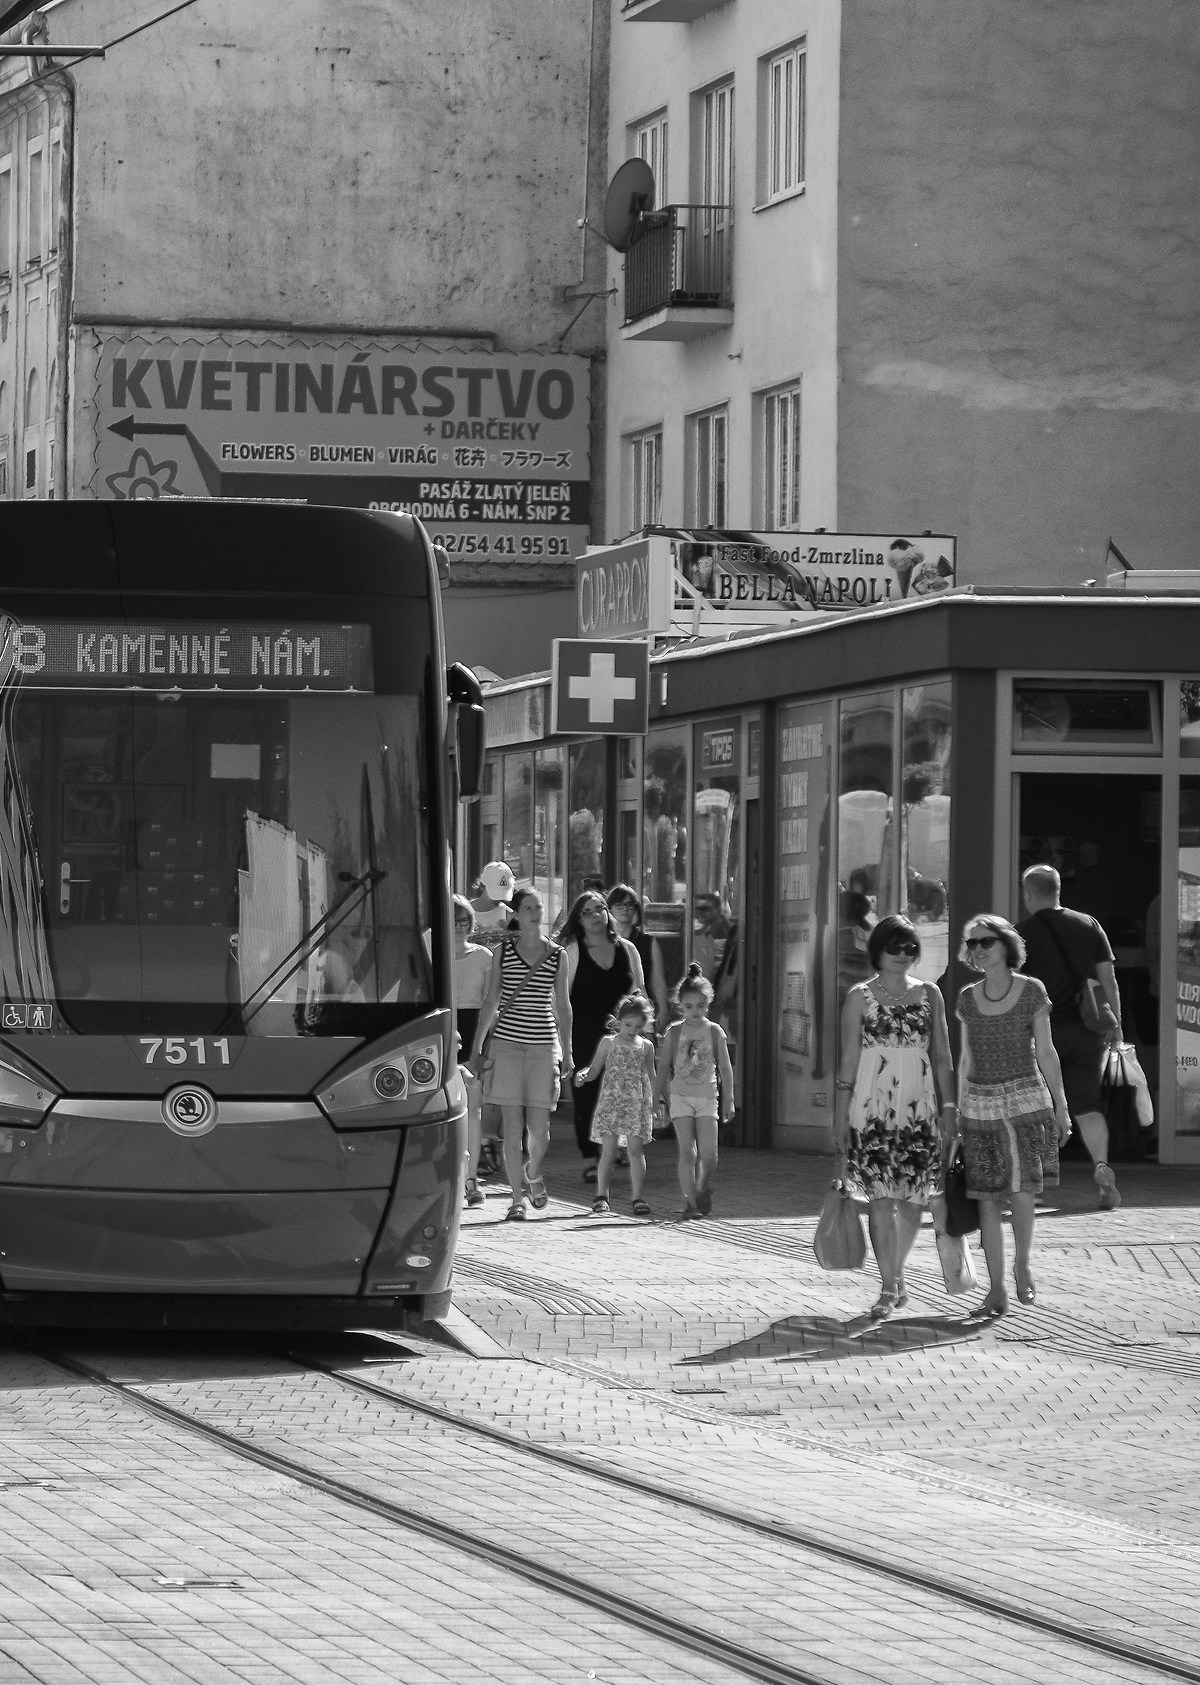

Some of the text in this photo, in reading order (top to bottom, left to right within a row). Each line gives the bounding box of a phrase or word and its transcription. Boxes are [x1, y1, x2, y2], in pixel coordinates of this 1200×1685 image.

[111, 352, 575, 419] KVETINÁRSTVO
[441, 417, 541, 440] DARČEKY
[221, 443, 438, 464] FLOWERS BLUMEN VIRÁG
[502, 451, 572, 468] フラワーズ
[420, 480, 571, 504] PASÁŽ ZLATÝ JELEŇ
[459, 503, 470, 519] 6
[482, 501, 523, 520] NÁM.
[527, 505, 558, 521] SNP
[561, 506, 571, 521] 2
[494, 536, 517, 554] 41
[521, 537, 544, 555] 95
[547, 538, 571, 556] 91
[721, 545, 885, 566] Fast Food-Zmrzlina
[719, 573, 893, 605] BELLA NAPOLI
[13, 625, 331, 677] 8 KAMENNÉ NÁM.
[140, 1037, 231, 1065] 7511
